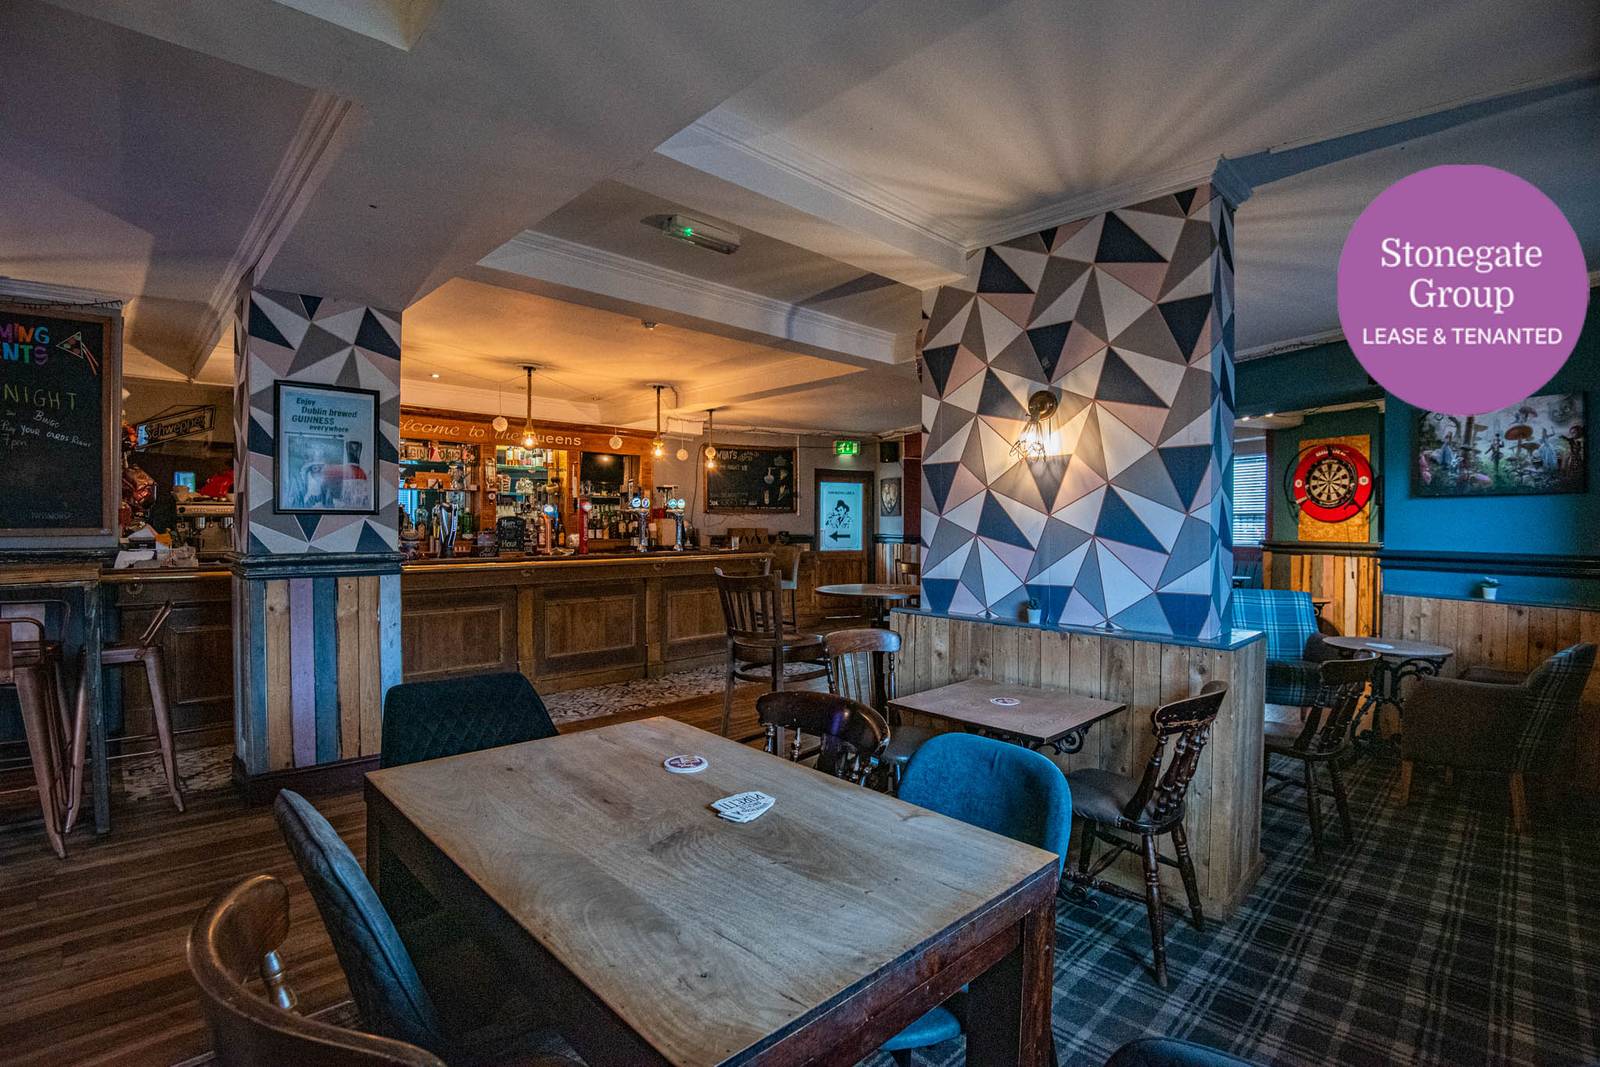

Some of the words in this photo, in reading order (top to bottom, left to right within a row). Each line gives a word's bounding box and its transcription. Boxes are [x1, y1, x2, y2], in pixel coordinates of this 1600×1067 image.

[3, 383, 78, 411] NIGHT
[296, 397, 316, 407] Enjoy
[301, 406, 328, 416] Dublin
[329, 408, 358, 418] brewed
[292, 414, 335, 426] GUINNESS
[309, 425, 349, 433] everywhere
[400, 419, 460, 437] elcome
[469, 424, 485, 438] to
[533, 431, 582, 446] ueens
